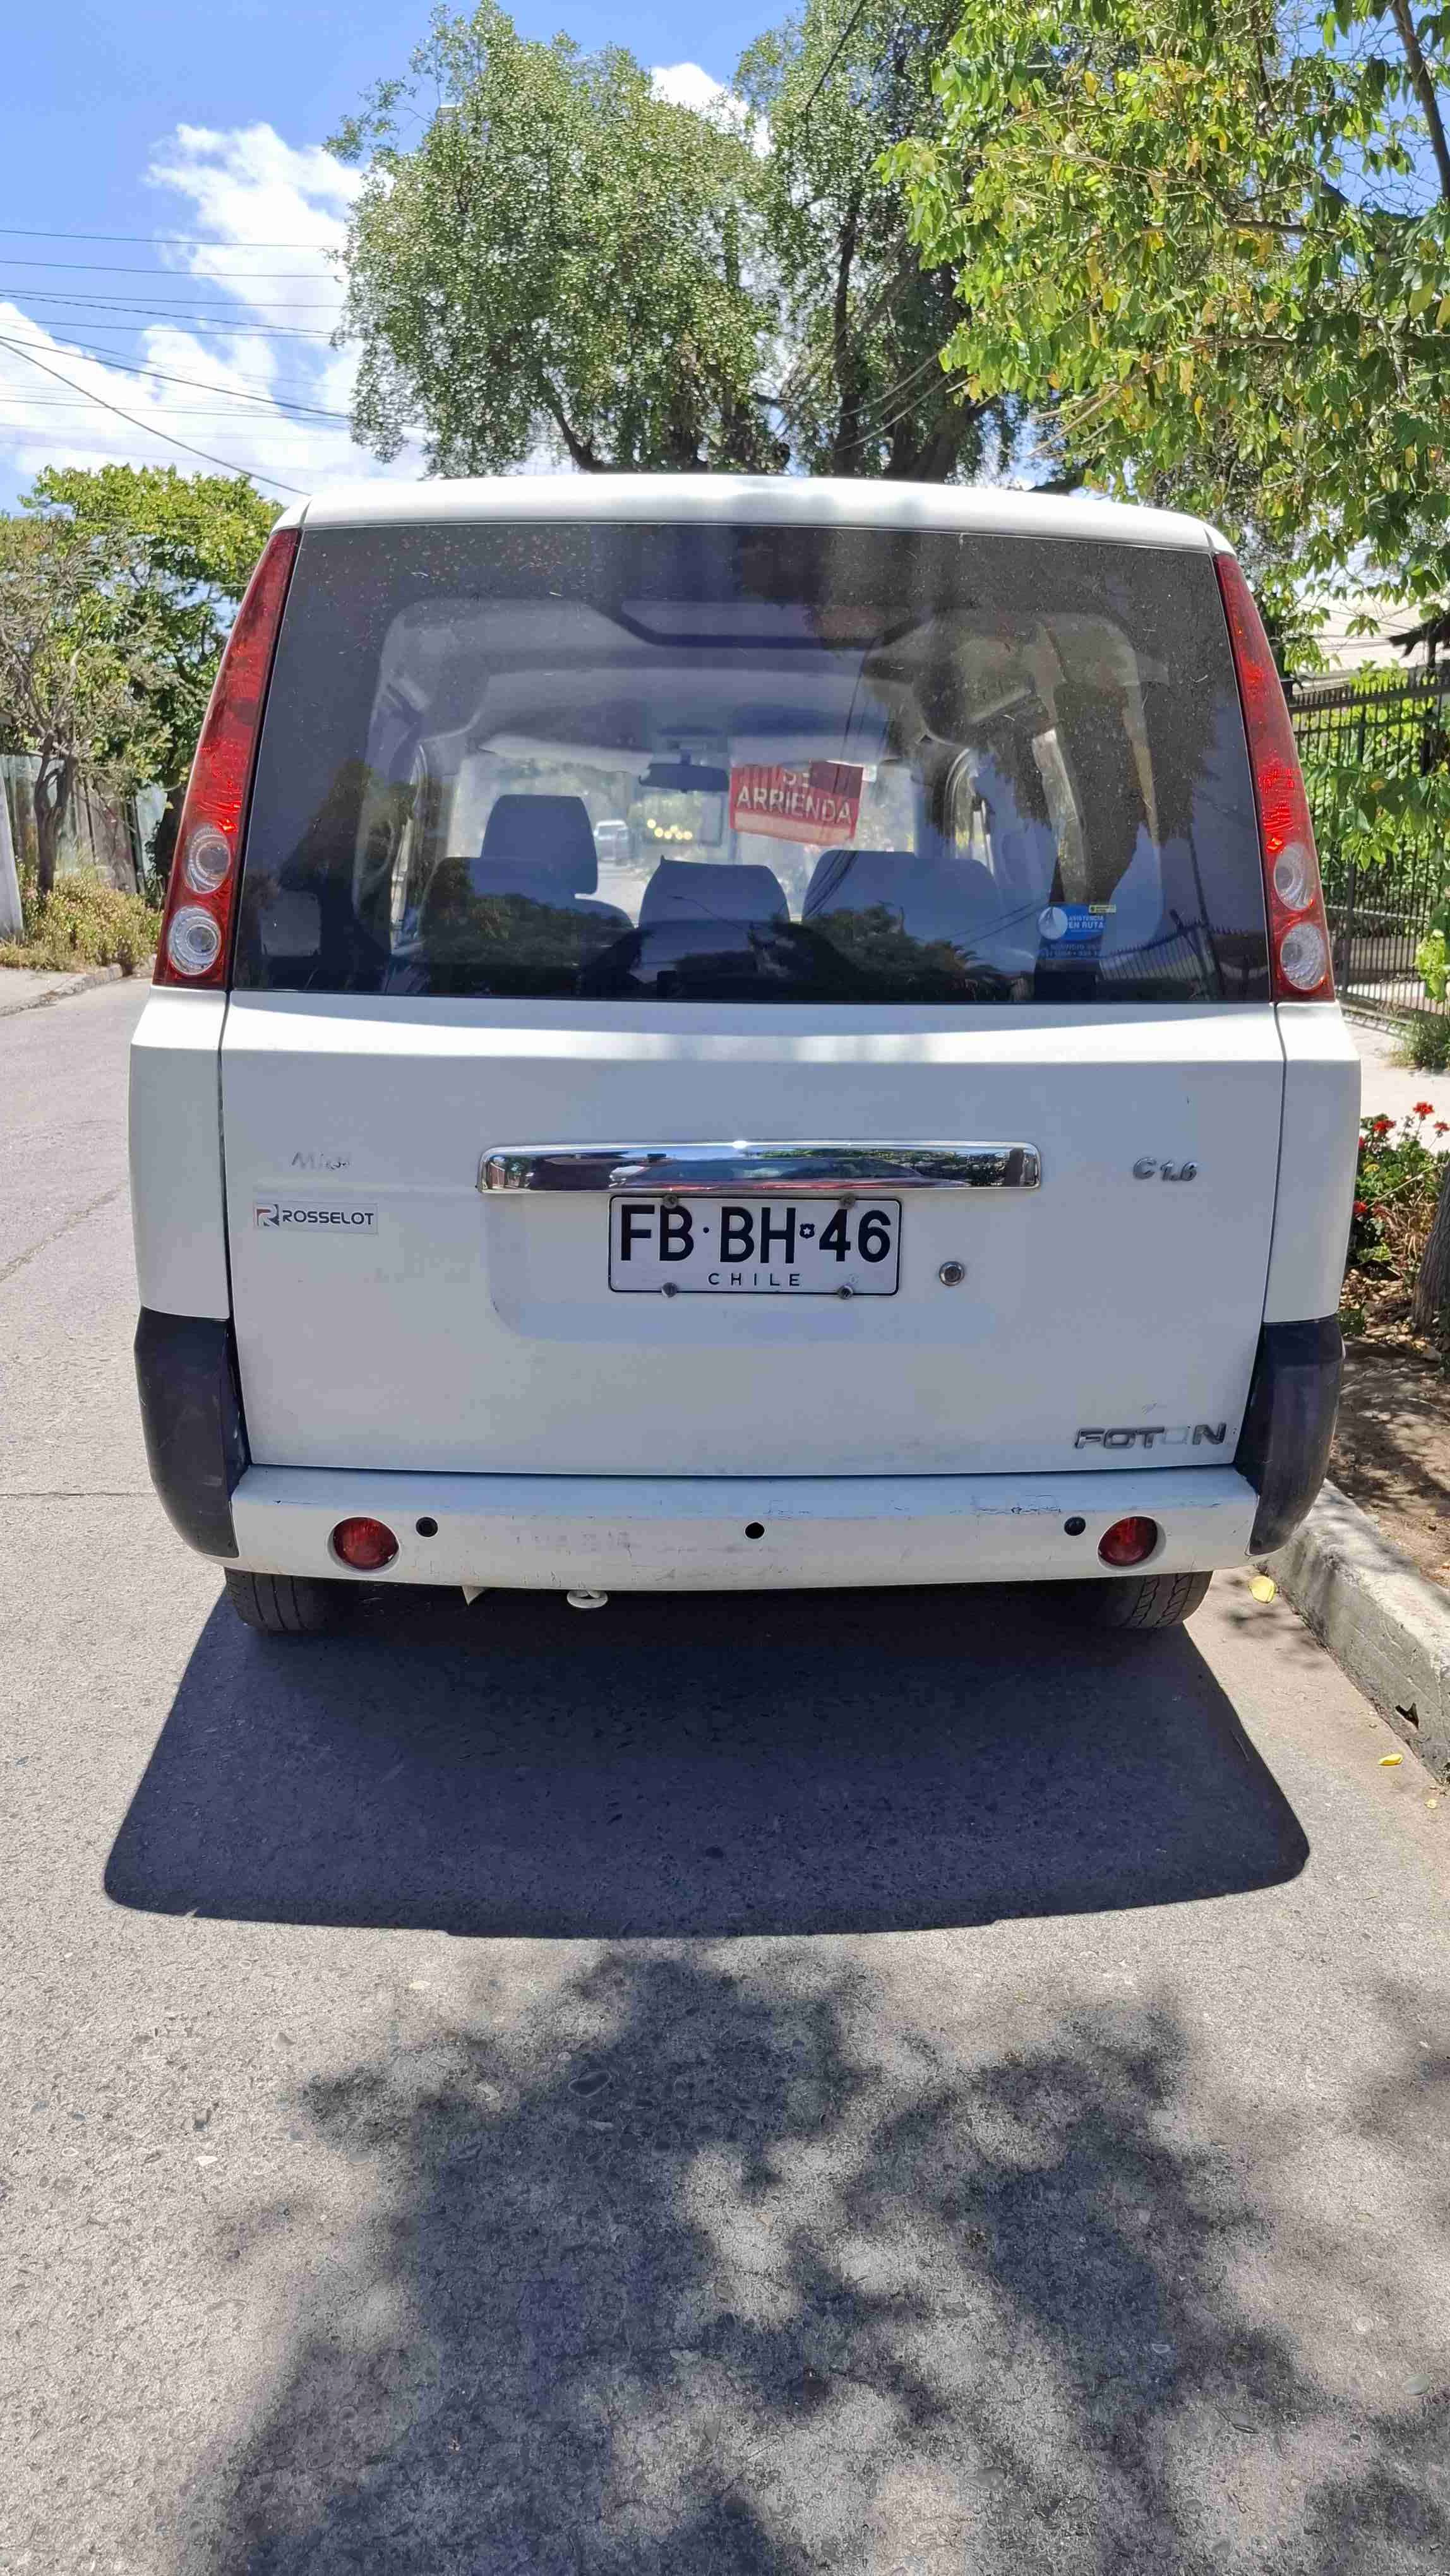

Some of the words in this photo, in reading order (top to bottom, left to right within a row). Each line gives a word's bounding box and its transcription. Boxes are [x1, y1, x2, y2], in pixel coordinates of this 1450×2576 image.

[736, 785, 852, 823] ARRIENDA
[282, 1210, 374, 1225] ROSSELOT
[708, 1272, 800, 1287] CHILE
[1074, 1422, 1226, 1449] FOTN
